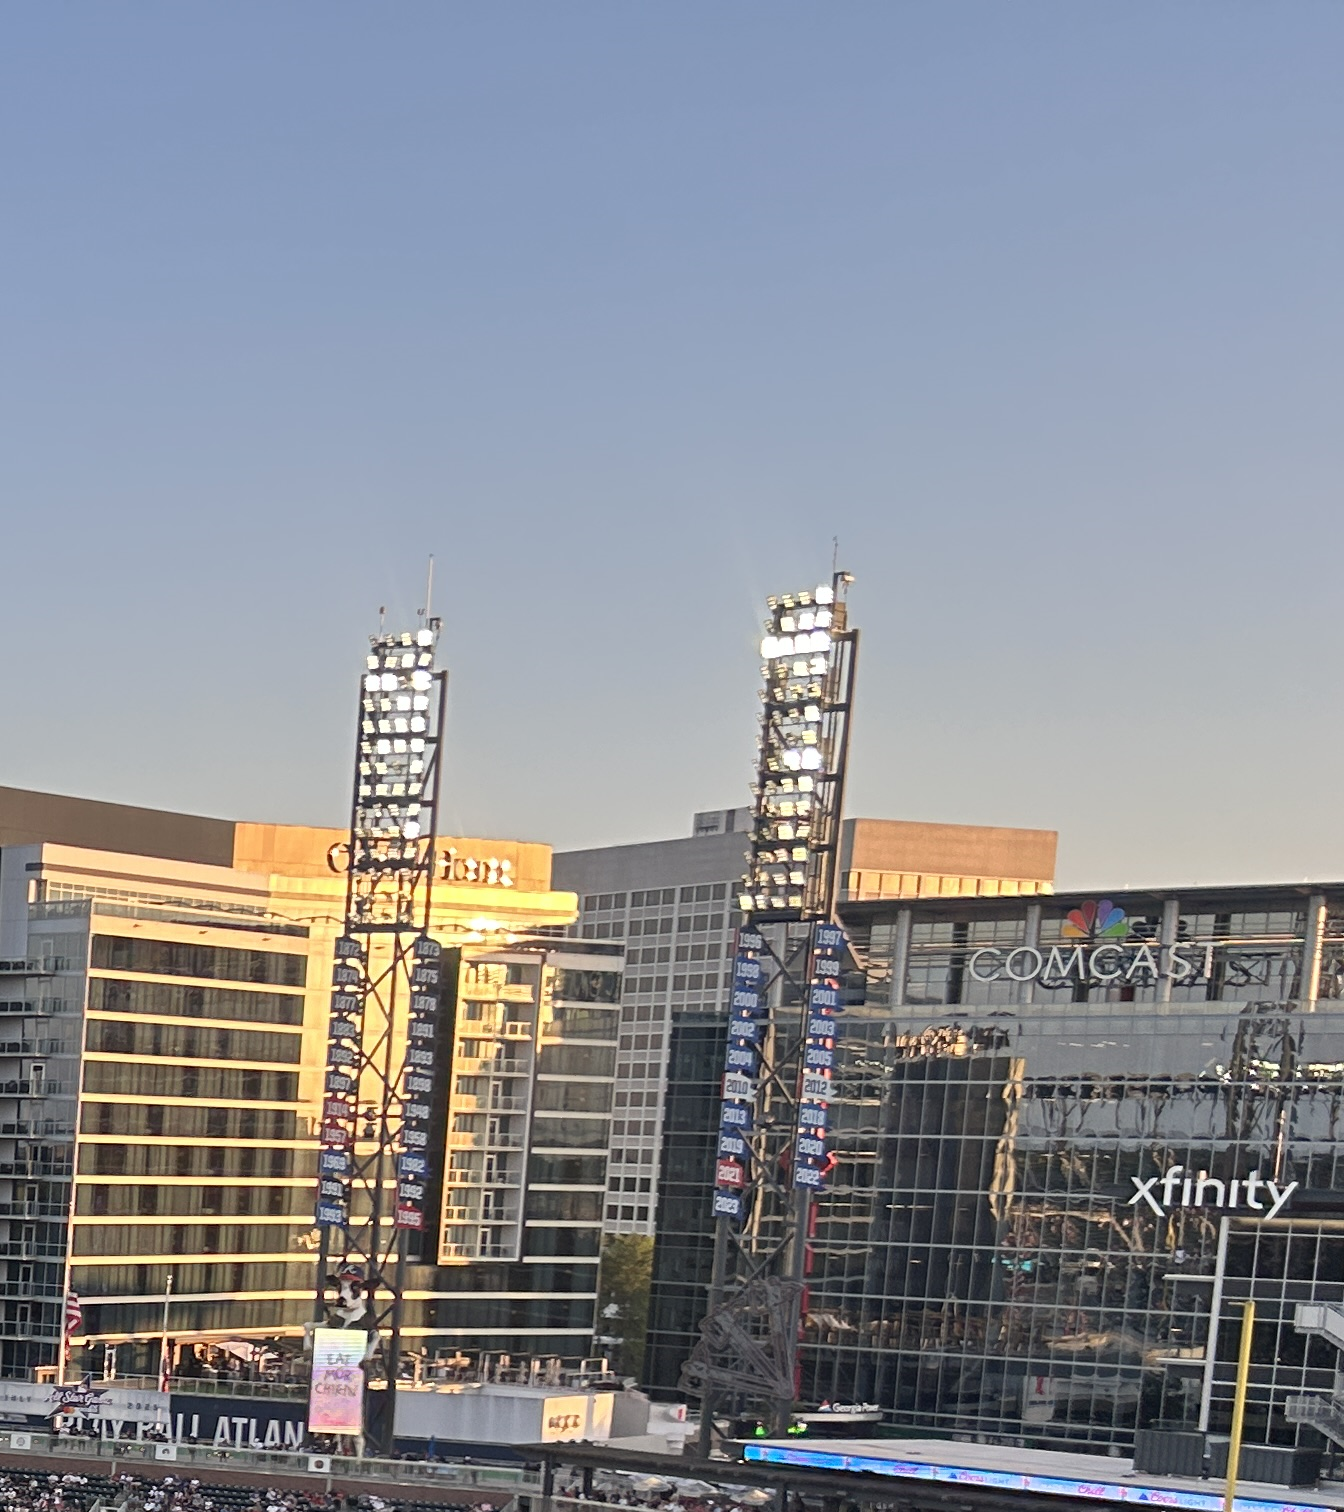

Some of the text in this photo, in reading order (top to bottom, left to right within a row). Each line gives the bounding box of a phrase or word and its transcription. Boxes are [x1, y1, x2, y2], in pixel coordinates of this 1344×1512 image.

[739, 933, 762, 949] 1996
[817, 930, 842, 946] 1997
[736, 961, 759, 978] 1998
[815, 959, 839, 976] 1999
[969, 942, 1222, 982] COMCAST
[734, 991, 758, 1008] 2000
[812, 989, 837, 1005] 2001
[731, 1020, 755, 1037] 2002
[810, 1019, 835, 1035] 2003
[728, 1050, 753, 1066] 2004
[807, 1049, 832, 1065] 2005
[726, 1078, 749, 1095] 2010
[805, 1078, 828, 1095] 2012
[723, 1108, 747, 1124] 2013
[802, 1109, 825, 1125] 2018
[325, 1128, 346, 1143] 1957
[721, 1137, 744, 1153] 2019
[799, 1138, 823, 1155] 2020
[323, 1154, 345, 1169] 1969
[402, 1156, 425, 1171] 1982
[718, 1166, 741, 1182] 2021
[796, 1168, 820, 1185] 2022
[321, 1181, 343, 1195] 1991
[400, 1184, 423, 1198] 1992
[1127, 1167, 1299, 1219] xfinity
[715, 1195, 739, 1212] 2023
[319, 1206, 341, 1221] 1993
[398, 1209, 421, 1225] 1995
[327, 1353, 351, 1366] EAT
